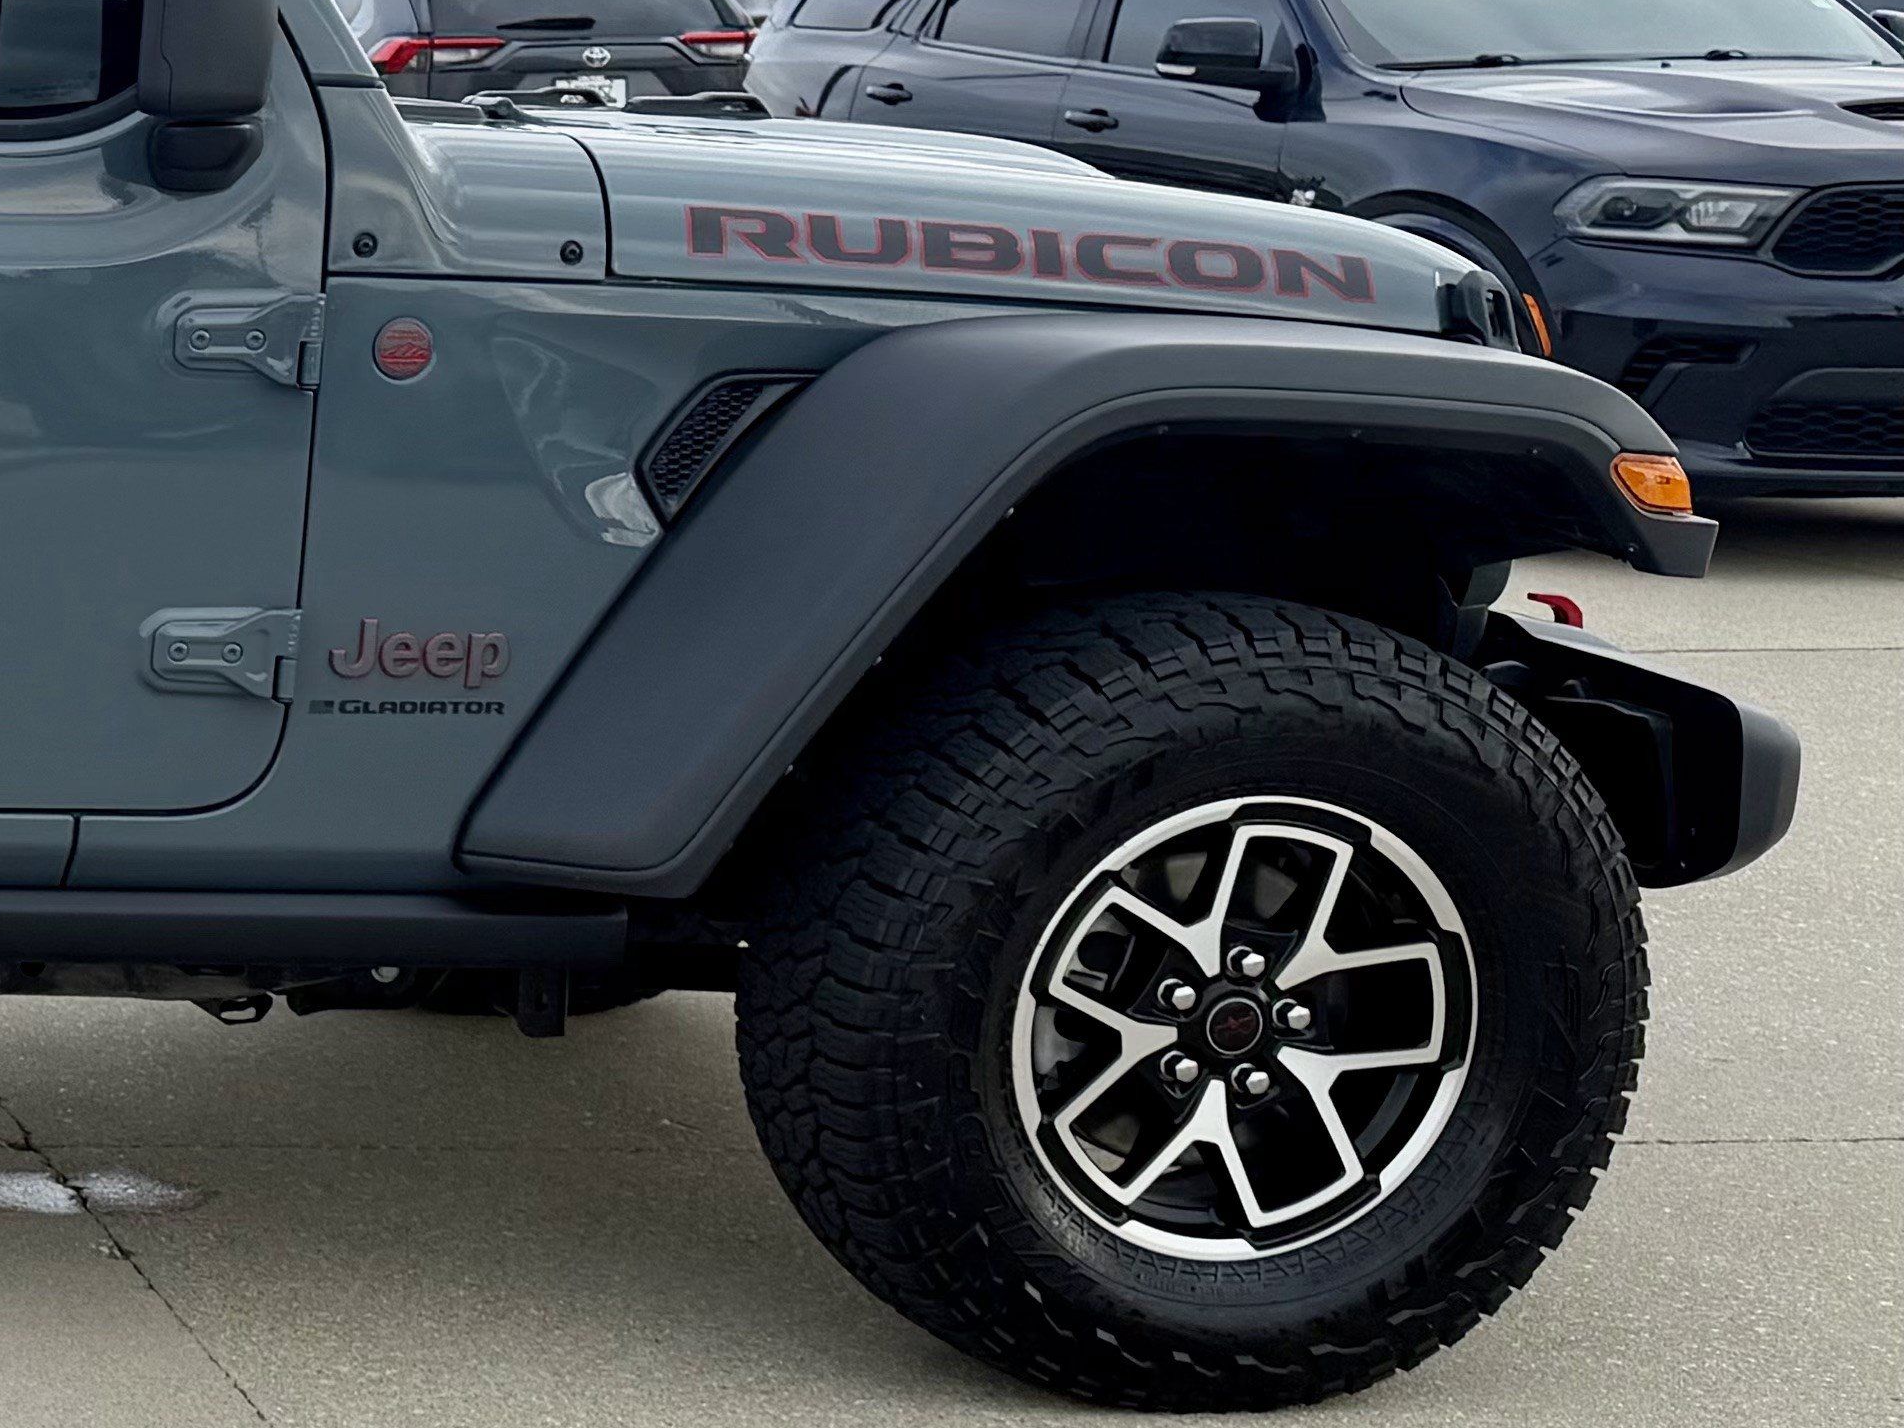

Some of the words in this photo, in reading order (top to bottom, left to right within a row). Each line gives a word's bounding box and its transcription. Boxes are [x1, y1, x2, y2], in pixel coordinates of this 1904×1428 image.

[684, 204, 1377, 304] RUBICON
[328, 617, 512, 690] Jeep
[337, 698, 506, 716] GLADIATOR
